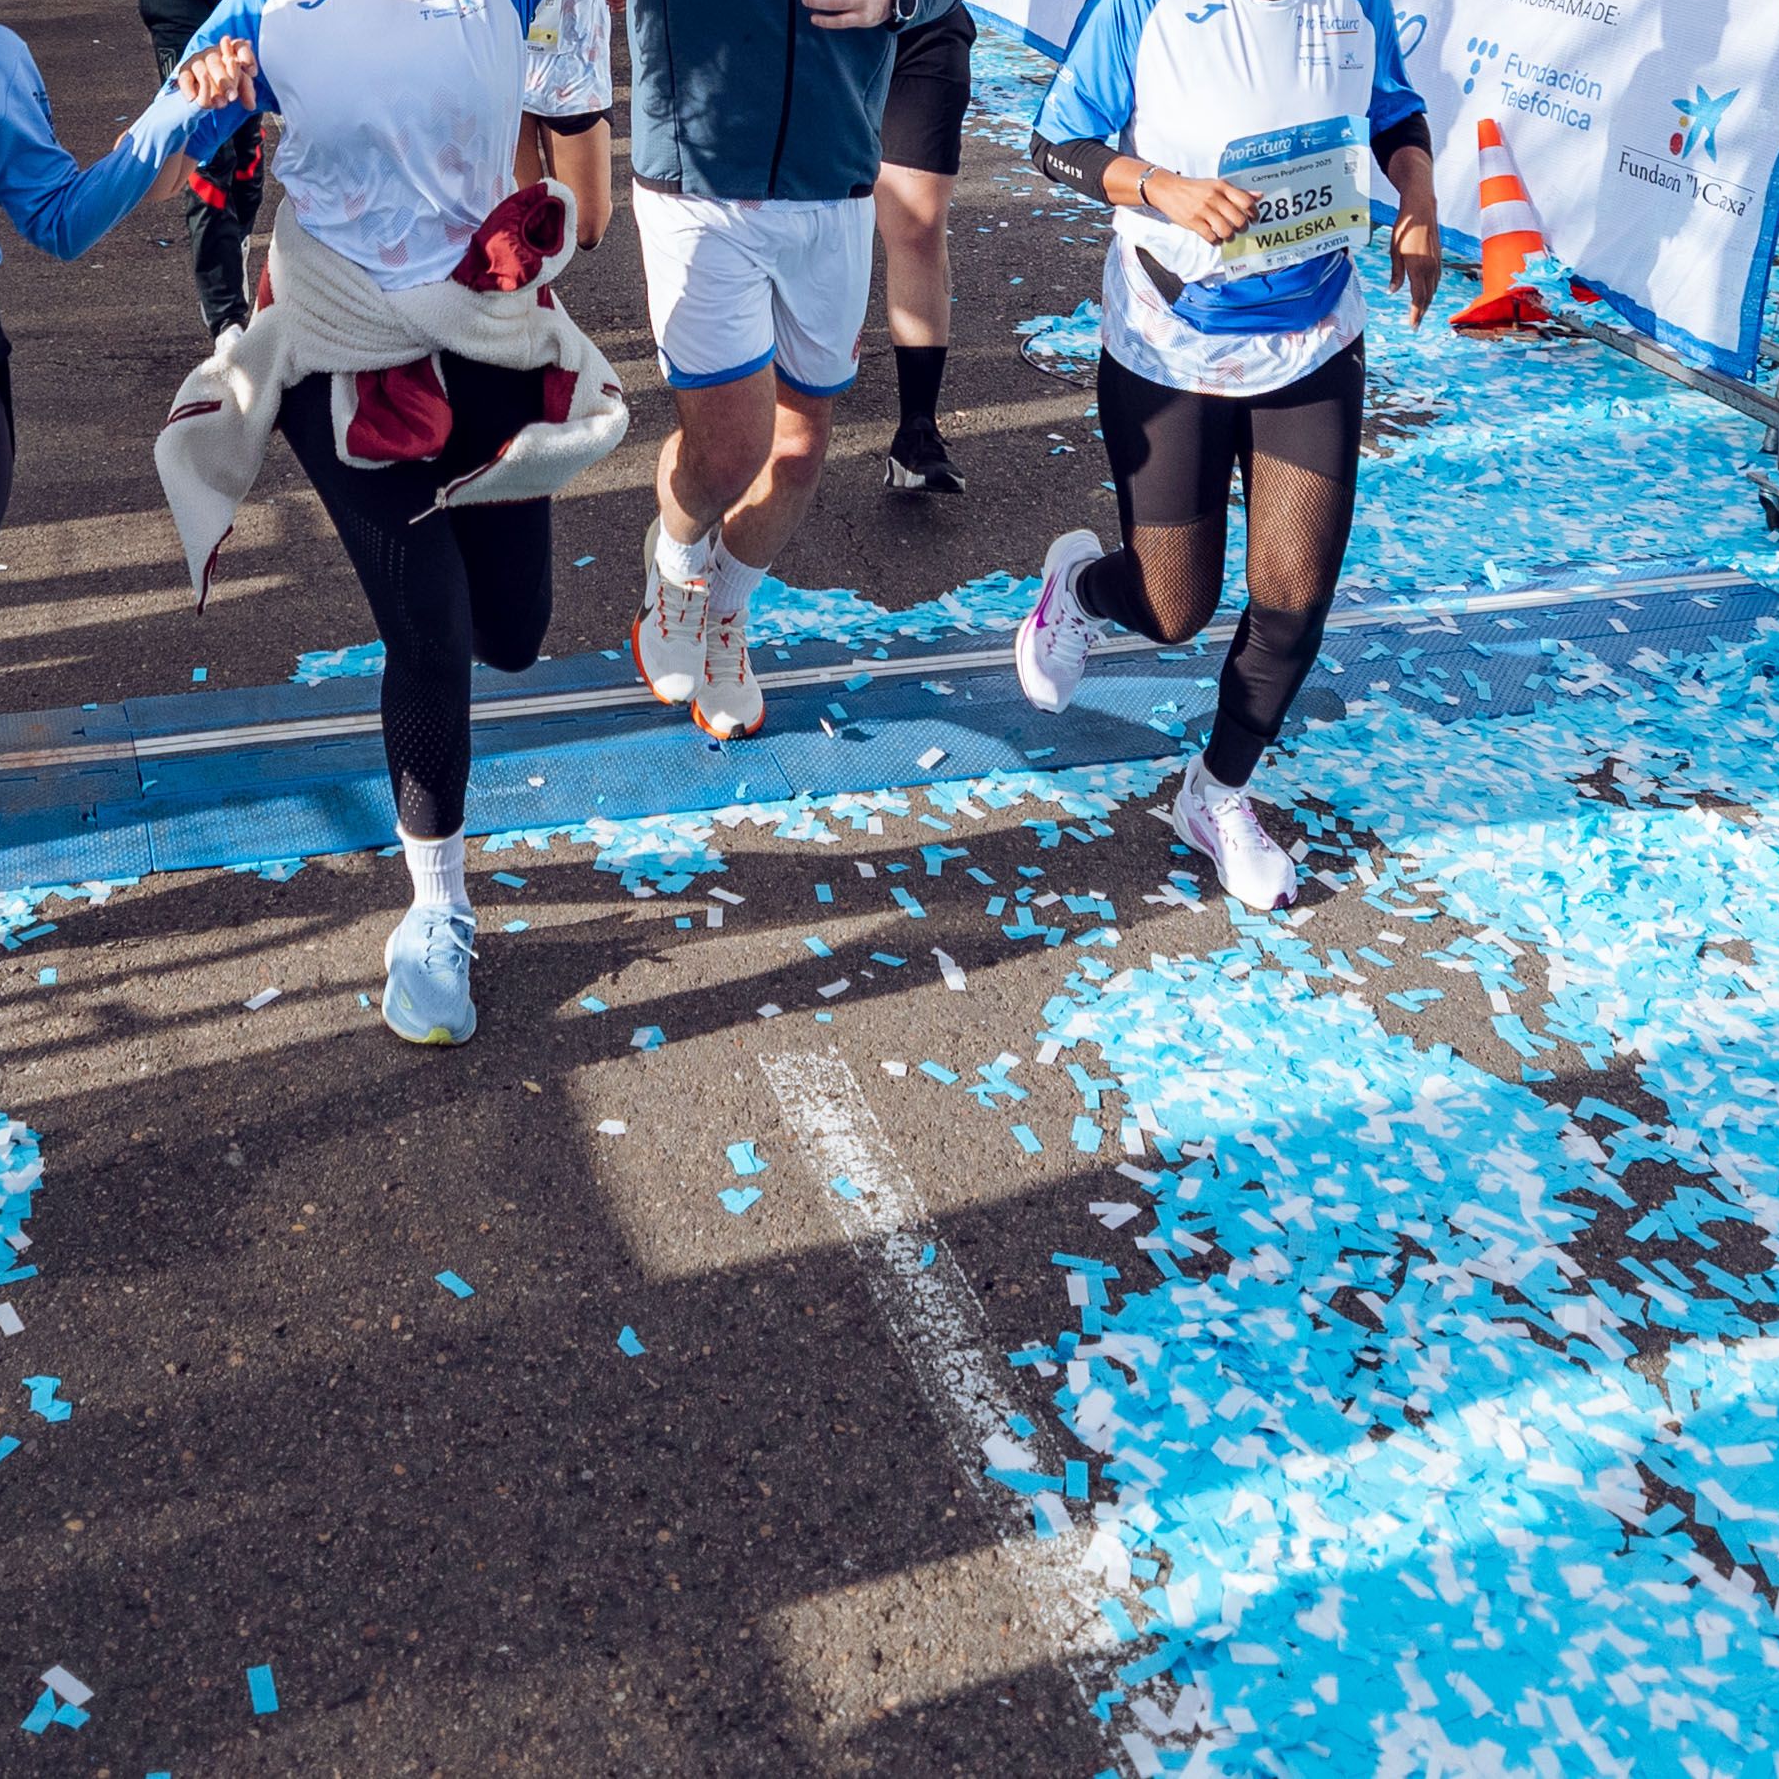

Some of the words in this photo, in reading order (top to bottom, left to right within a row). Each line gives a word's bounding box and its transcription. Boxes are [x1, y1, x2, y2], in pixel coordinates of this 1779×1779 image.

[1503, 52, 1603, 101] Fundación
[1501, 82, 1592, 132] Telefónica
[1047, 152, 1083, 180] KIPSTA
[1224, 137, 1292, 164] ProFuturo
[1251, 172, 1280, 183] Carrera
[1280, 162, 1315, 178] ProFuturo
[1315, 158, 1333, 168] 2025
[1258, 184, 1334, 225] 28525
[1255, 216, 1337, 250] WALESKA
